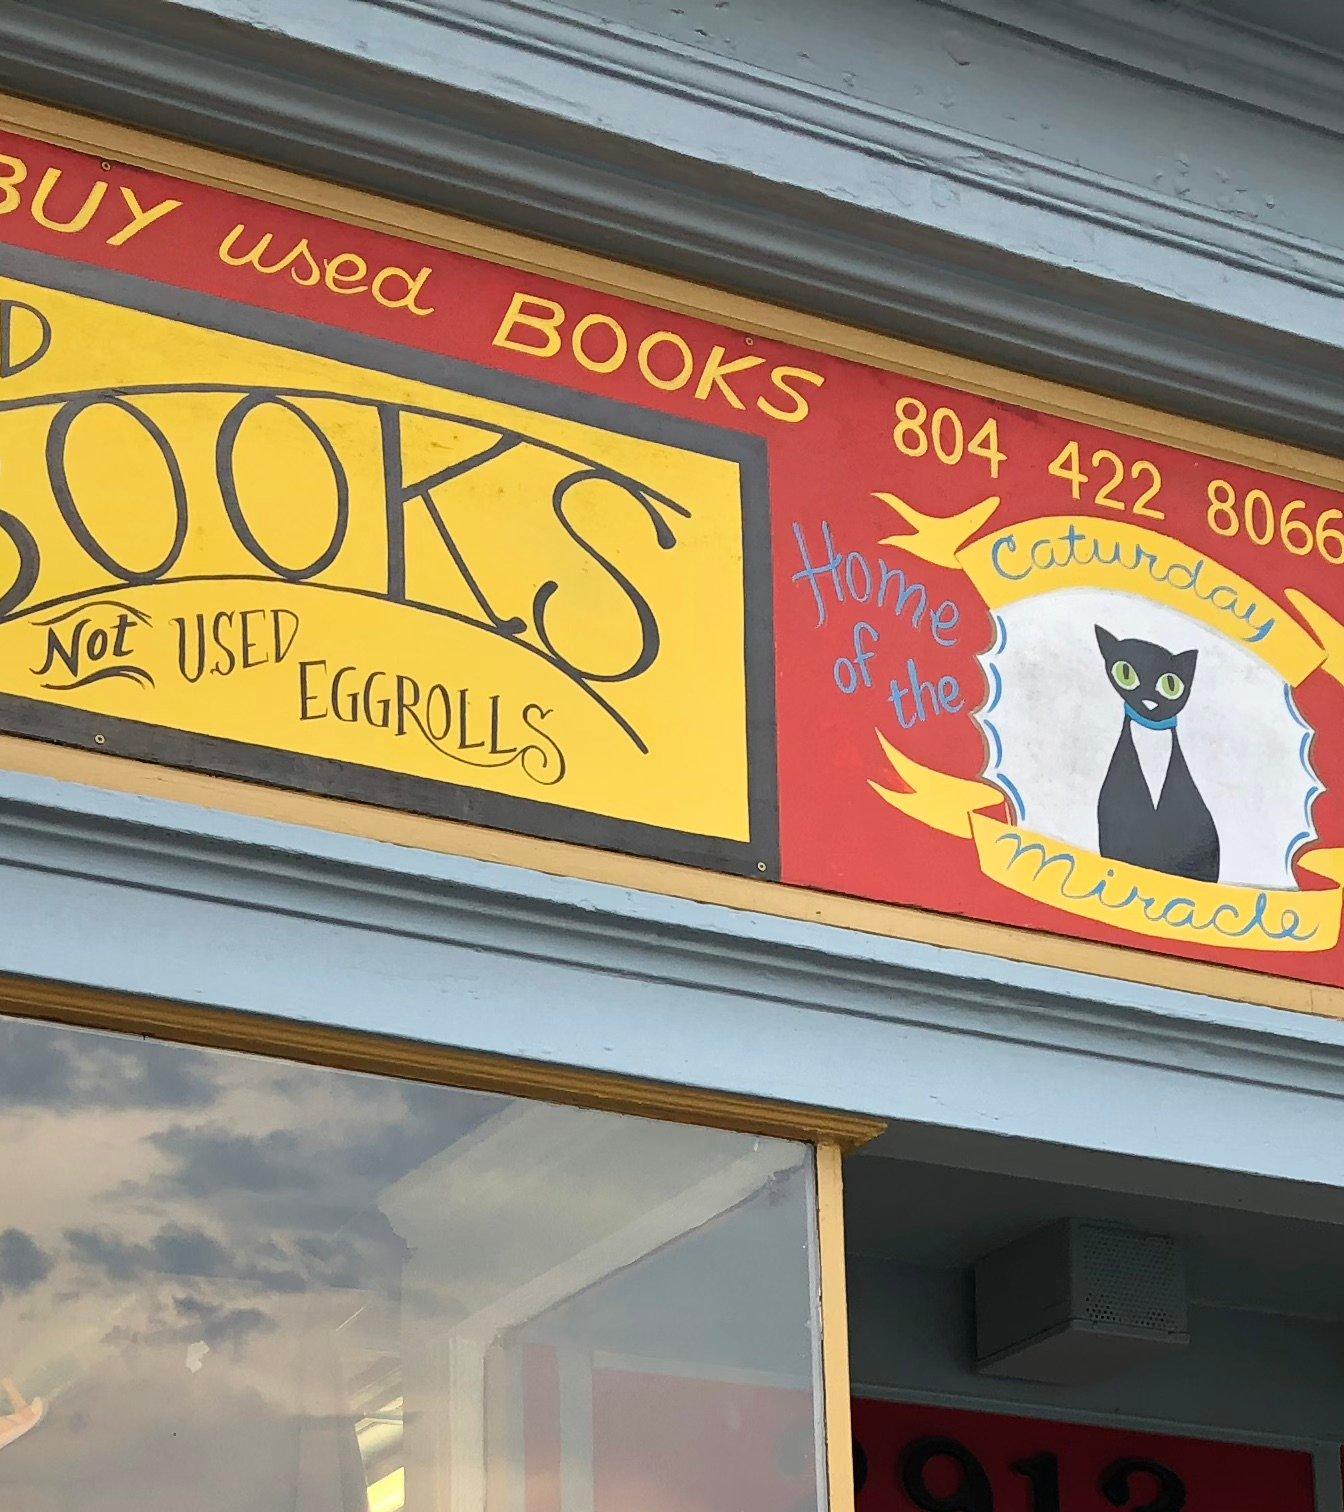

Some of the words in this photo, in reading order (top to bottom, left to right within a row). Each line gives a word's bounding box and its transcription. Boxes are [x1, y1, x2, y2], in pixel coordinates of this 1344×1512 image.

[218, 224, 436, 316] used
[492, 292, 825, 423] BOOKS
[892, 396, 1007, 479] 804
[1047, 442, 1166, 521] 422
[792, 521, 960, 646] Home
[992, 525, 1274, 641] Caturday
[177, 610, 299, 683] USED
[834, 622, 878, 693] of
[888, 659, 965, 728] the
[300, 660, 565, 785] EGGROLLS
